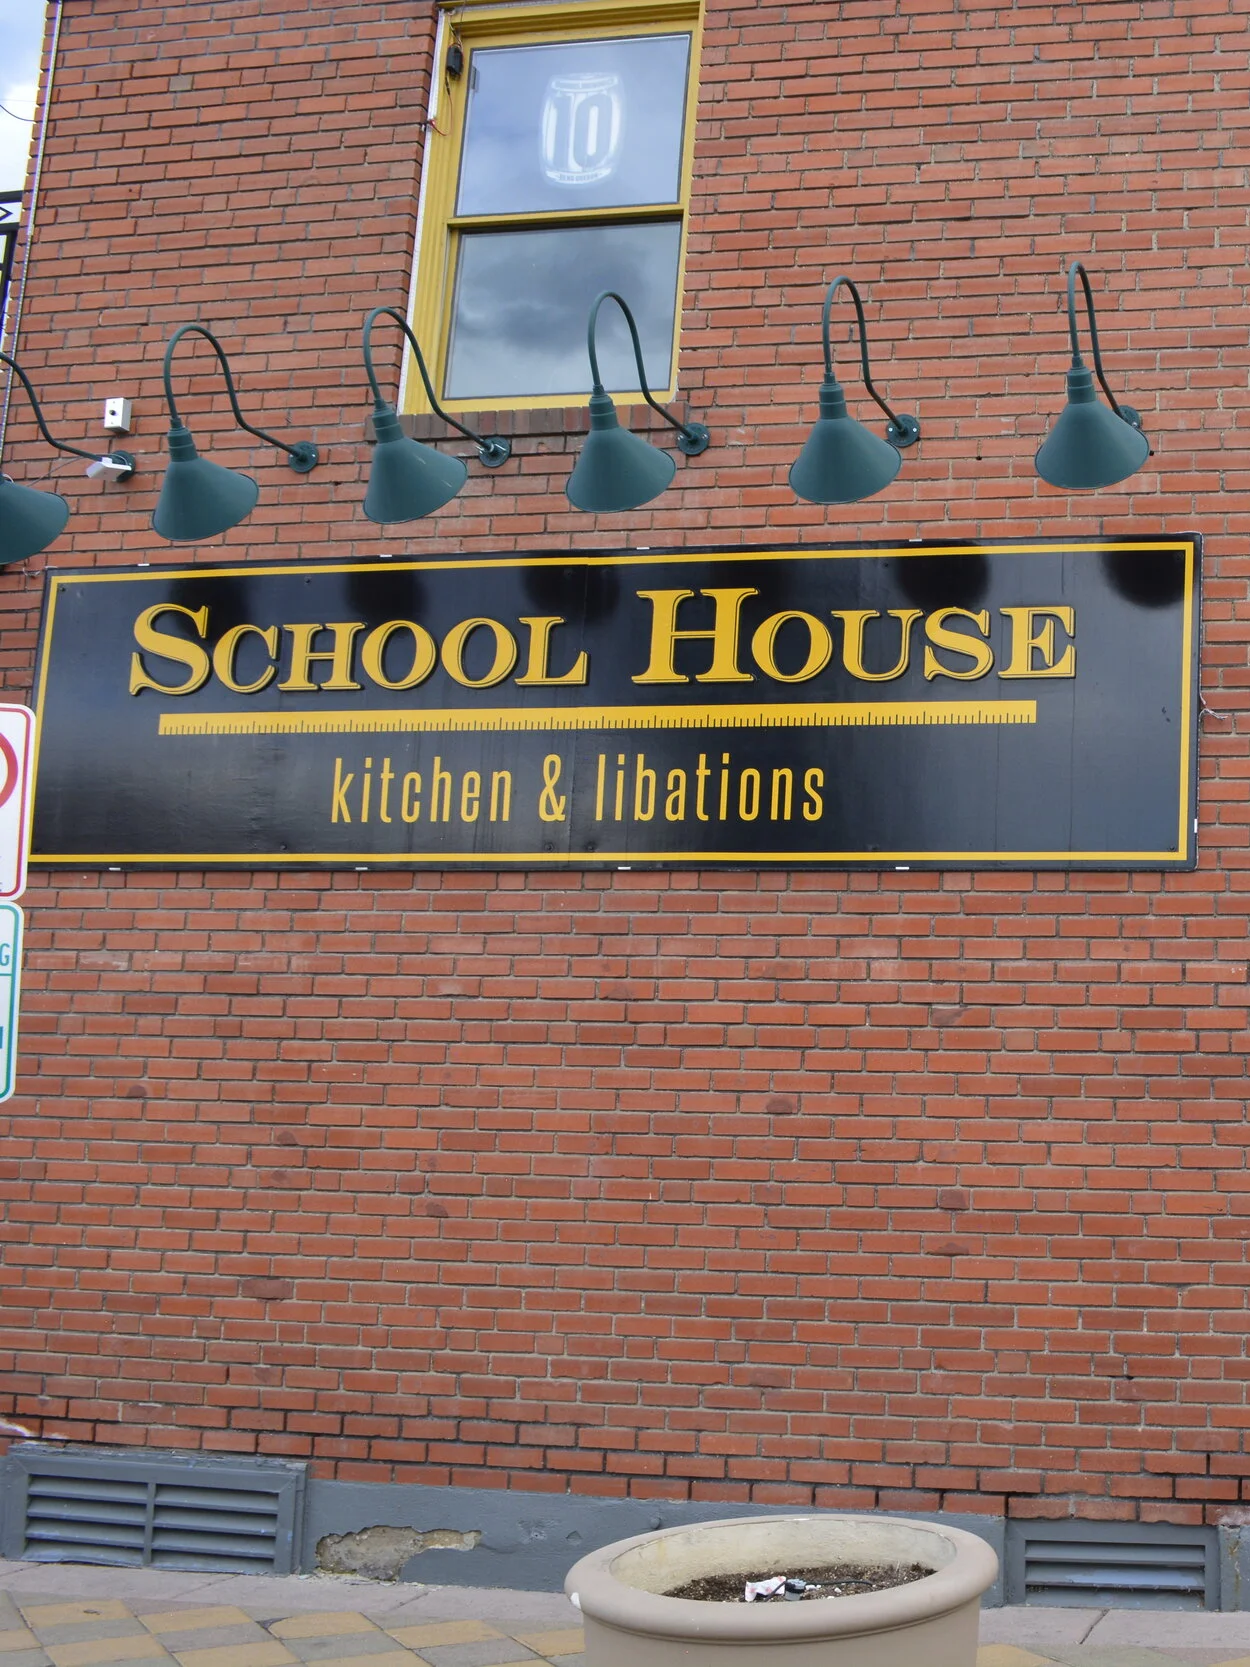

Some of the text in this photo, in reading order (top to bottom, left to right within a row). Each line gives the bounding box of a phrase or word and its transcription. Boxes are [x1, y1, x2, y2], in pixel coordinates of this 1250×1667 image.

[128, 587, 1077, 696] SCHOOL HOUSE
[331, 752, 824, 824] kitchen & libations
